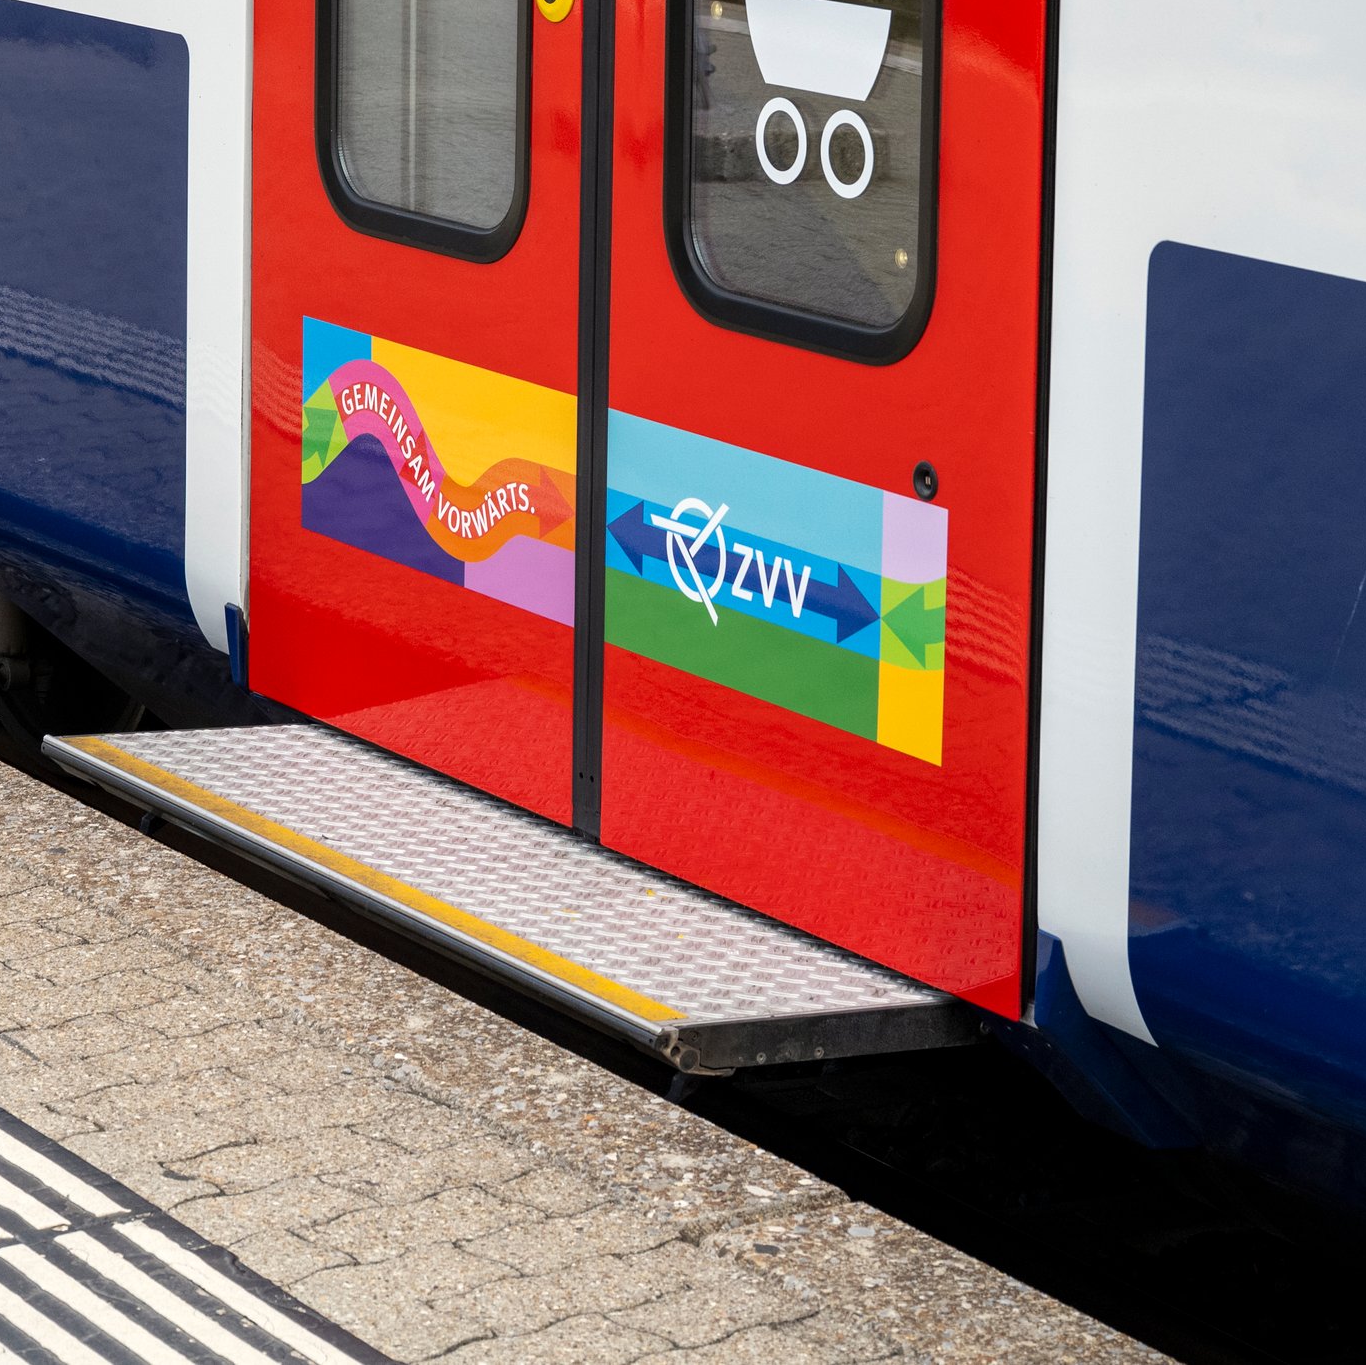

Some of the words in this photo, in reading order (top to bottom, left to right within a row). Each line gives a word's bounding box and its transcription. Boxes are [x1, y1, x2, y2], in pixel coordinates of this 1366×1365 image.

[342, 383, 435, 503] GEMEINSAM
[437, 482, 535, 538] VORWÄRTS.
[732, 542, 811, 618] ZVV
